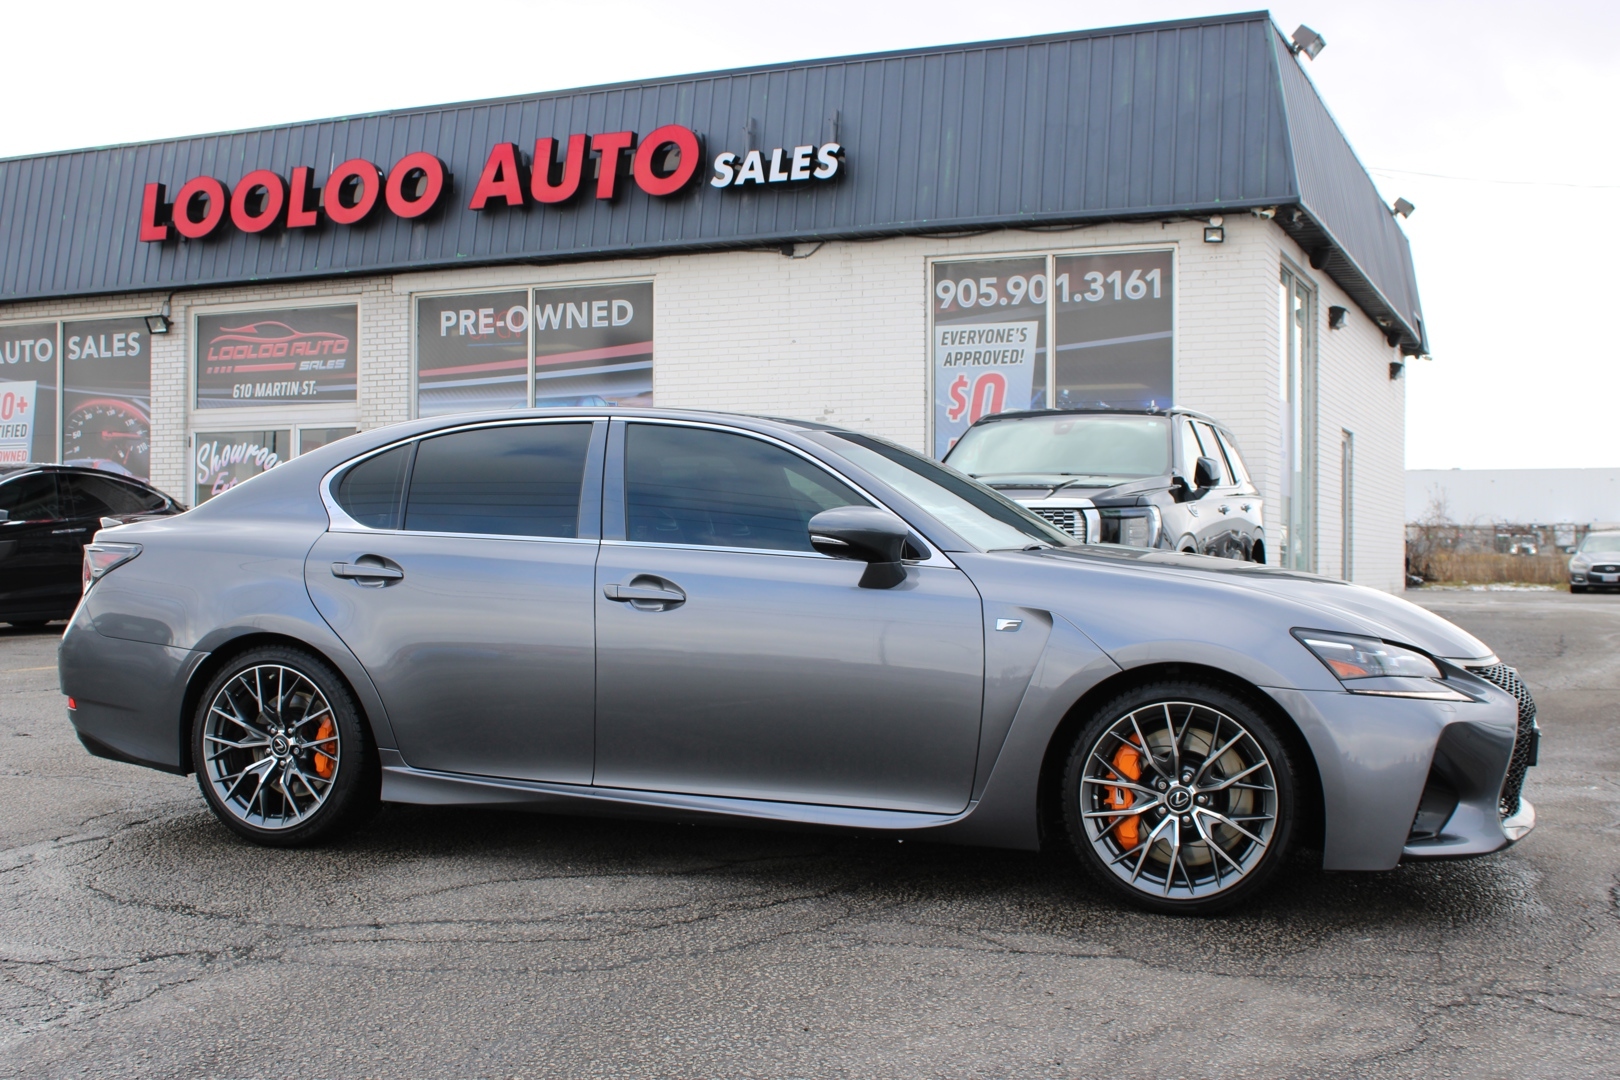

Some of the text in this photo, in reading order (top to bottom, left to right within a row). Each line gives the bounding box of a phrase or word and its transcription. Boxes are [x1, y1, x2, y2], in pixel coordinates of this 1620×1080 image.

[139, 124, 702, 243] LOOLOO AUTO
[710, 143, 842, 189] SALES
[935, 268, 1162, 309] 905.901.3161
[440, 299, 634, 337] PRE-OWNED
[0, 331, 141, 365] UTO SALES
[207, 339, 350, 362] LOOLOO AUTO
[941, 327, 1028, 346] EVERYONE'S
[298, 358, 347, 371] SALES
[943, 349, 1025, 367] APPROVED!
[232, 380, 317, 399] 610 MARTIN ST.
[948, 373, 1006, 426] $0
[197, 440, 282, 484] Showroo
